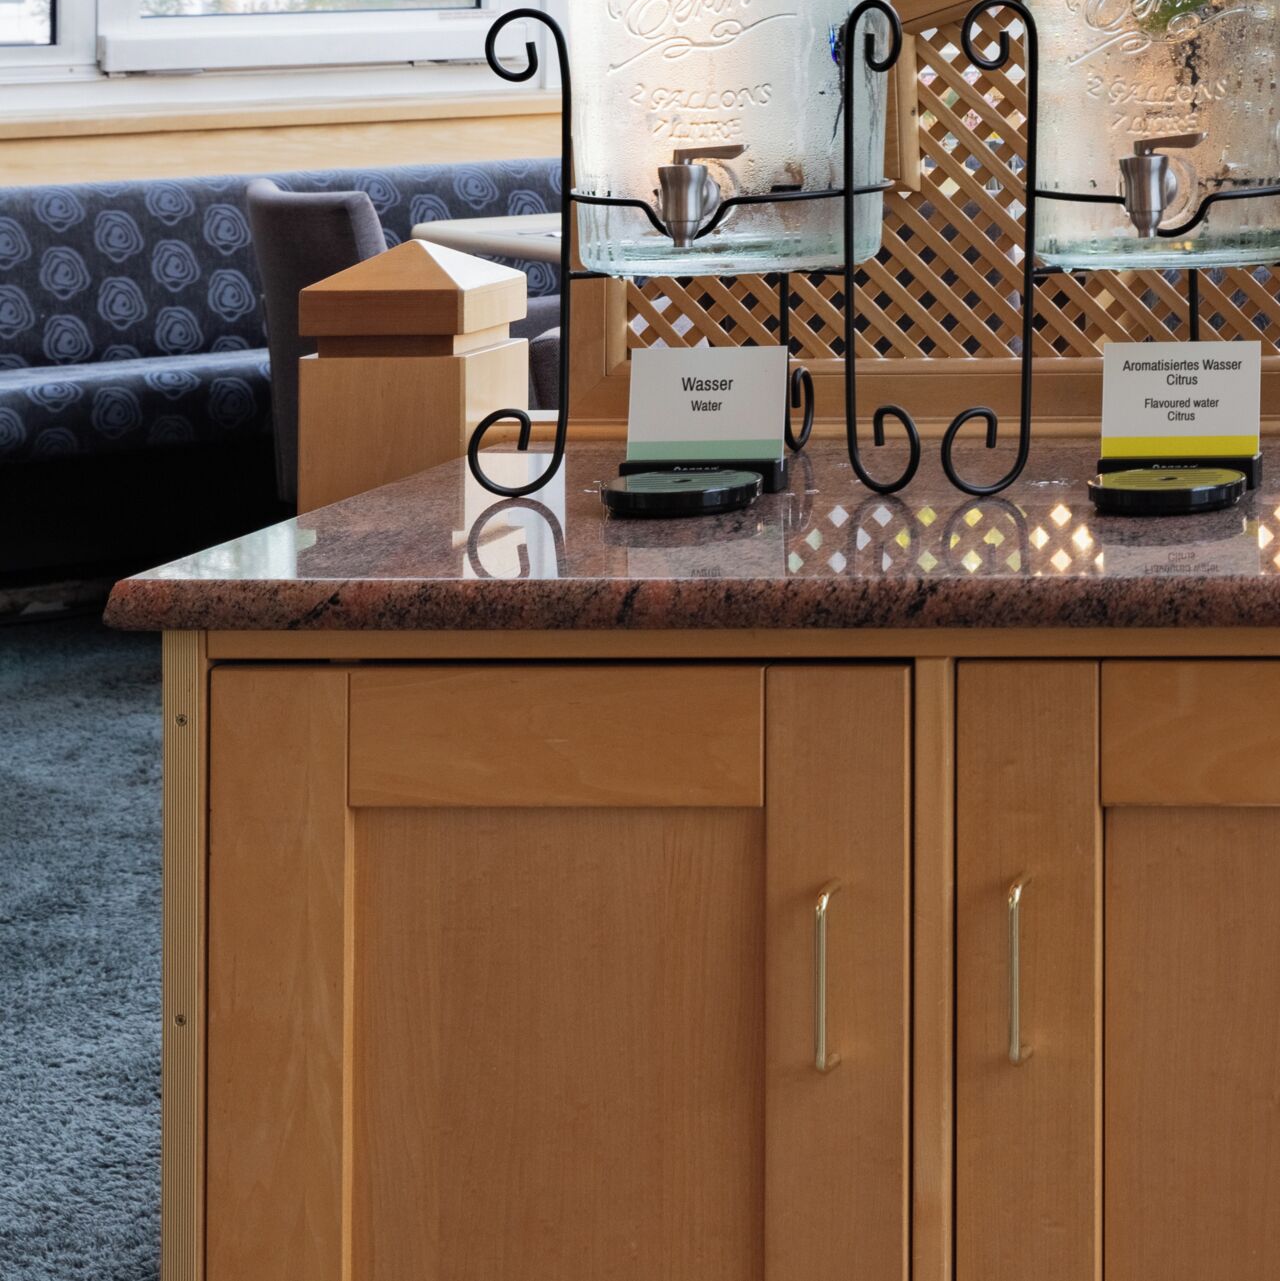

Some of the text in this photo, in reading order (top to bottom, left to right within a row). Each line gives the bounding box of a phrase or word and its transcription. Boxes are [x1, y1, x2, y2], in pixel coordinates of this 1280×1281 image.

[629, 81, 773, 111] 2 GALLONS
[1122, 359, 1242, 371] Aromatisiertes Wasser
[681, 376, 733, 391] Wasser
[1166, 373, 1198, 385] Citrus
[690, 399, 722, 411] Water
[1144, 398, 1219, 408] Flavoured water
[1166, 410, 1195, 421] Citrus
